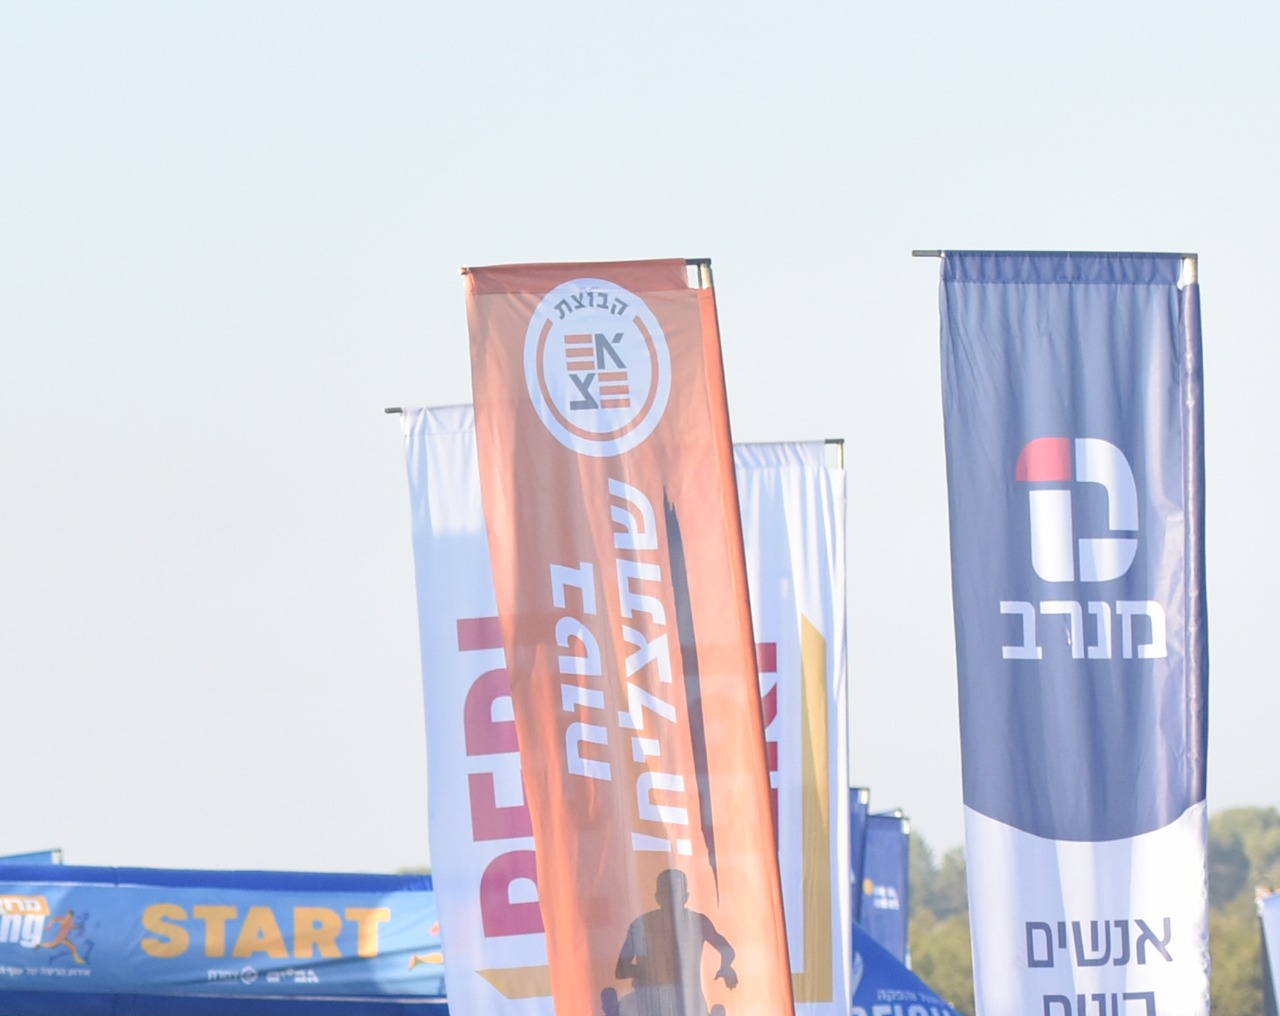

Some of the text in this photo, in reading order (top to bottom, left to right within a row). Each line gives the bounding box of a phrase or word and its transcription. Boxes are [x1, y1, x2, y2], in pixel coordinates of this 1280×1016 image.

[554, 291, 629, 319] קבוצת
[1000, 600, 1167, 660] מנרב
[549, 561, 612, 781] בטוח
[607, 477, 693, 856] שתצליח!
[140, 902, 391, 958] START
[1025, 917, 1173, 968] אנשים
